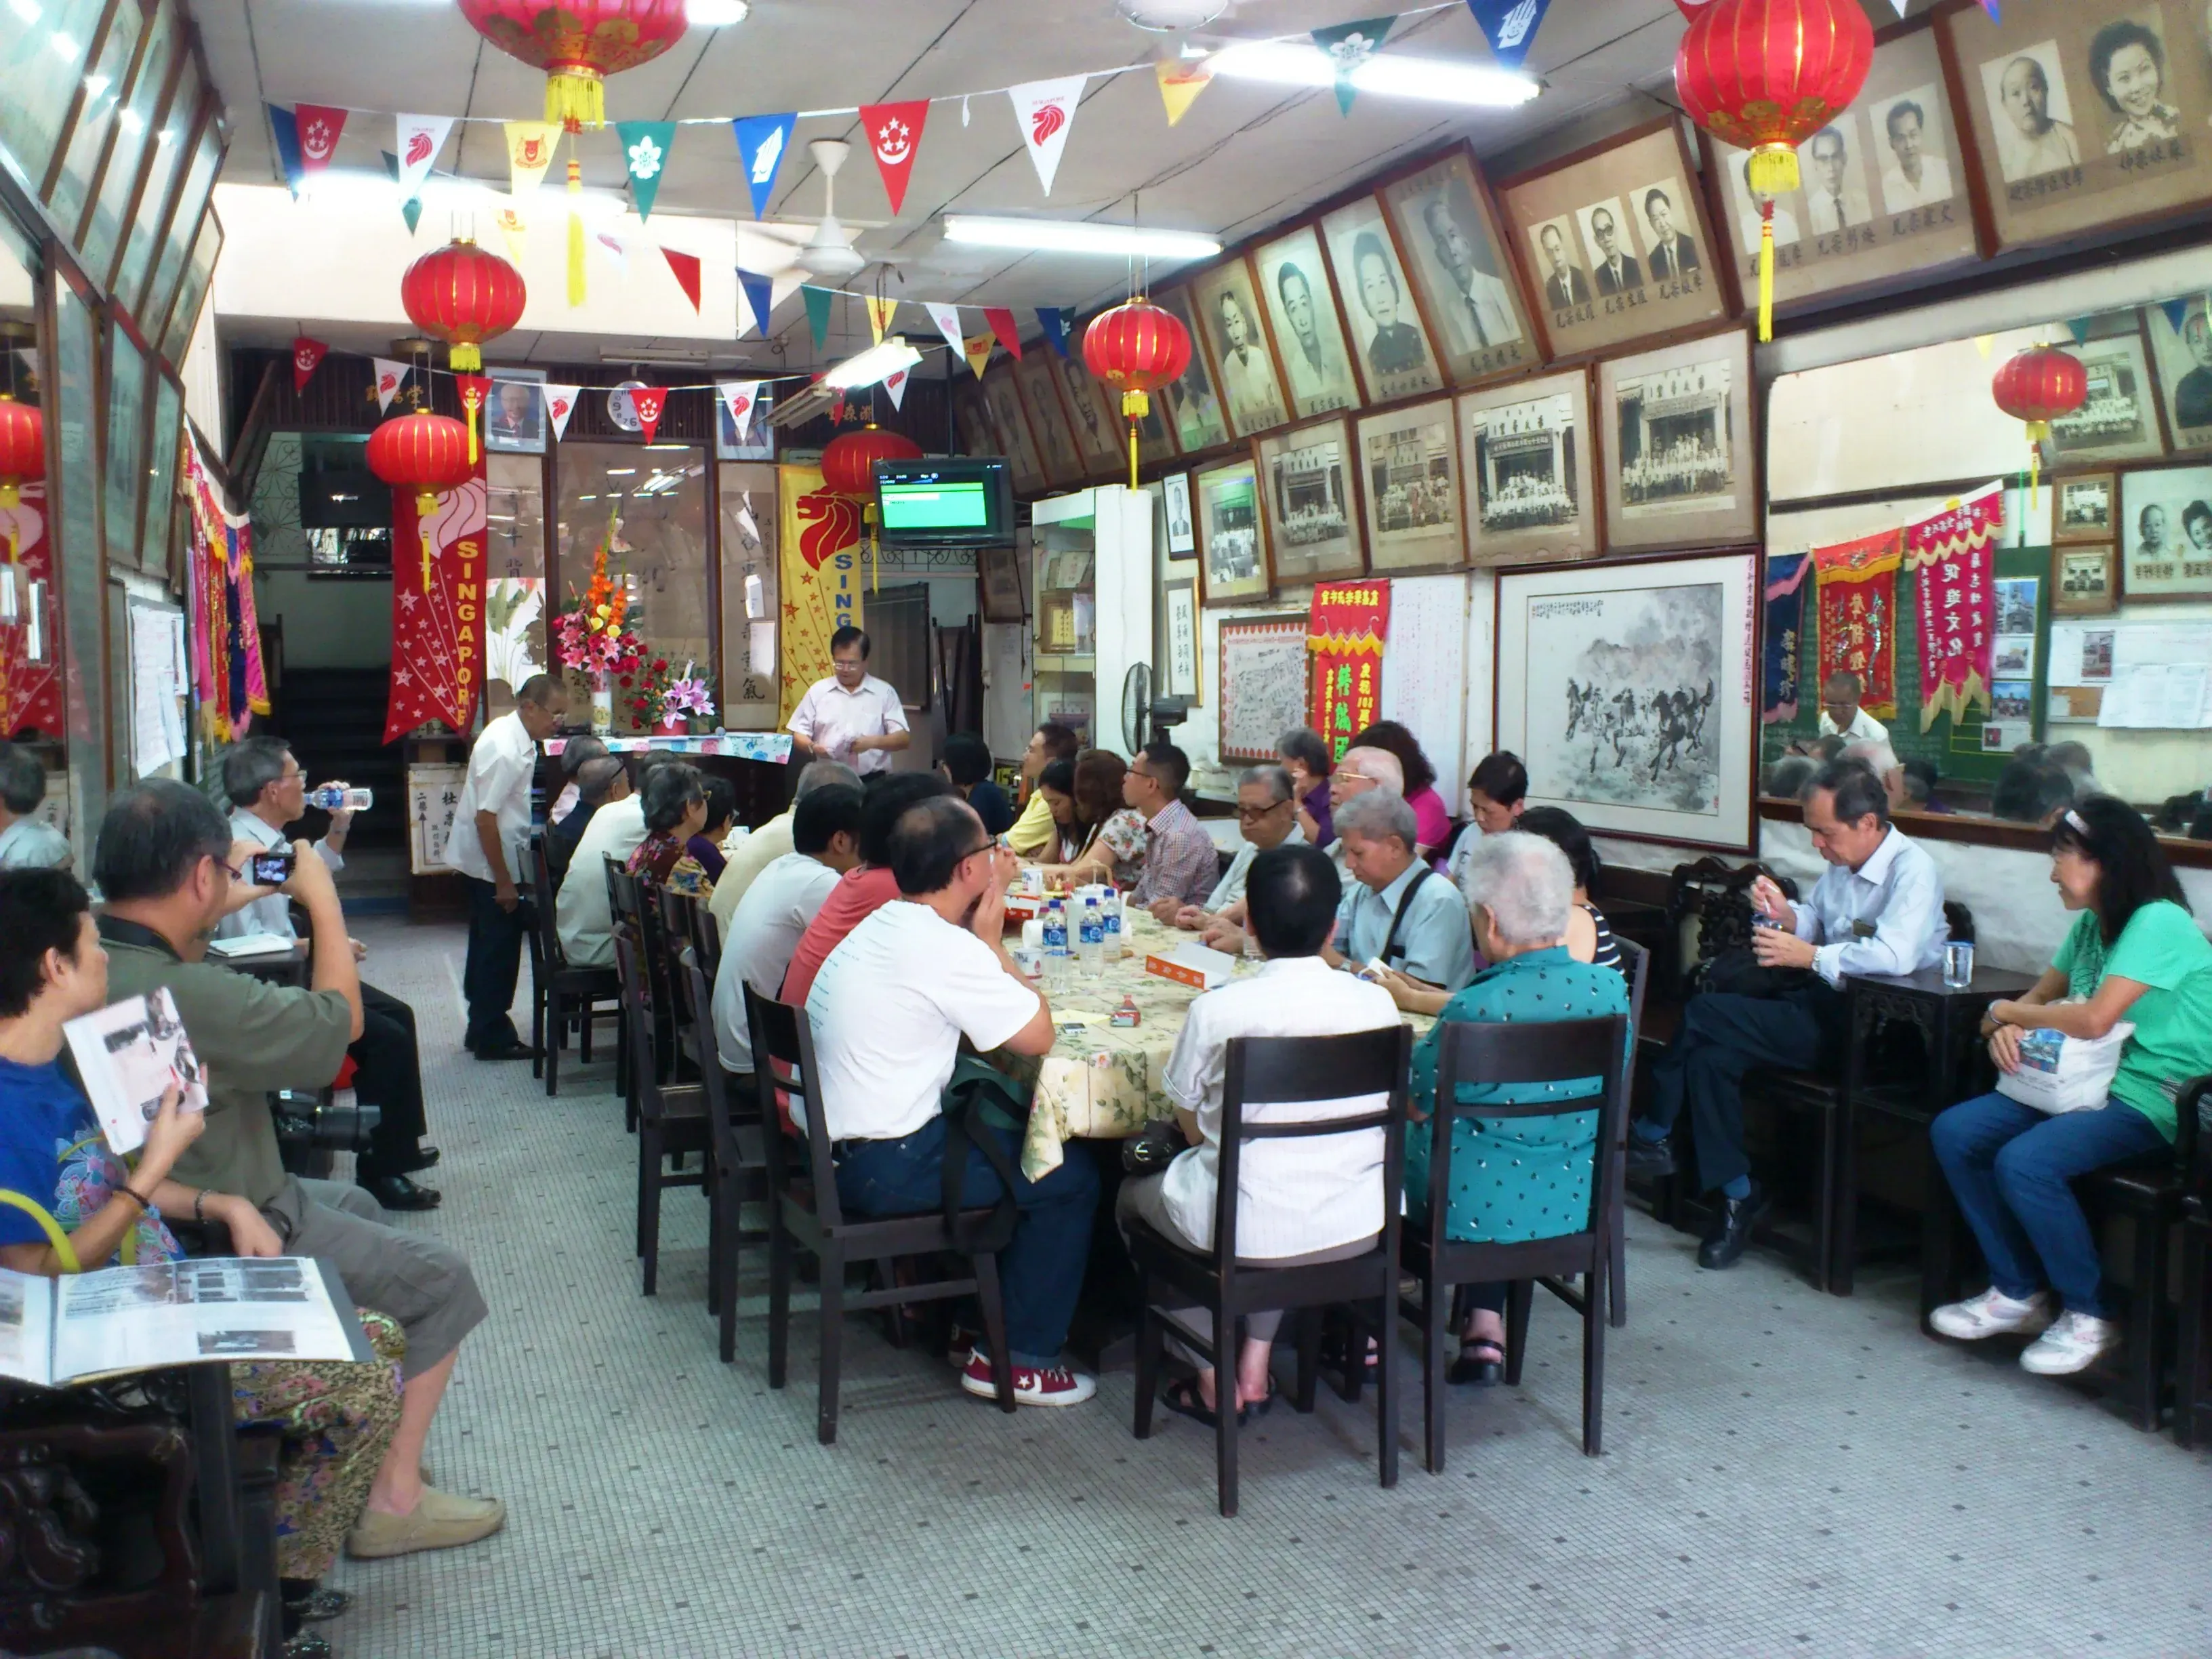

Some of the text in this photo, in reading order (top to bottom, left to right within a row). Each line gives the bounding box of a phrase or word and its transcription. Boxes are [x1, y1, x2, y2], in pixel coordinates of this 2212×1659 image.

[613, 403, 621, 411] 9
[630, 418, 637, 427] 6
[835, 554, 853, 629] SING
[457, 541, 479, 726] SINGAPORE
